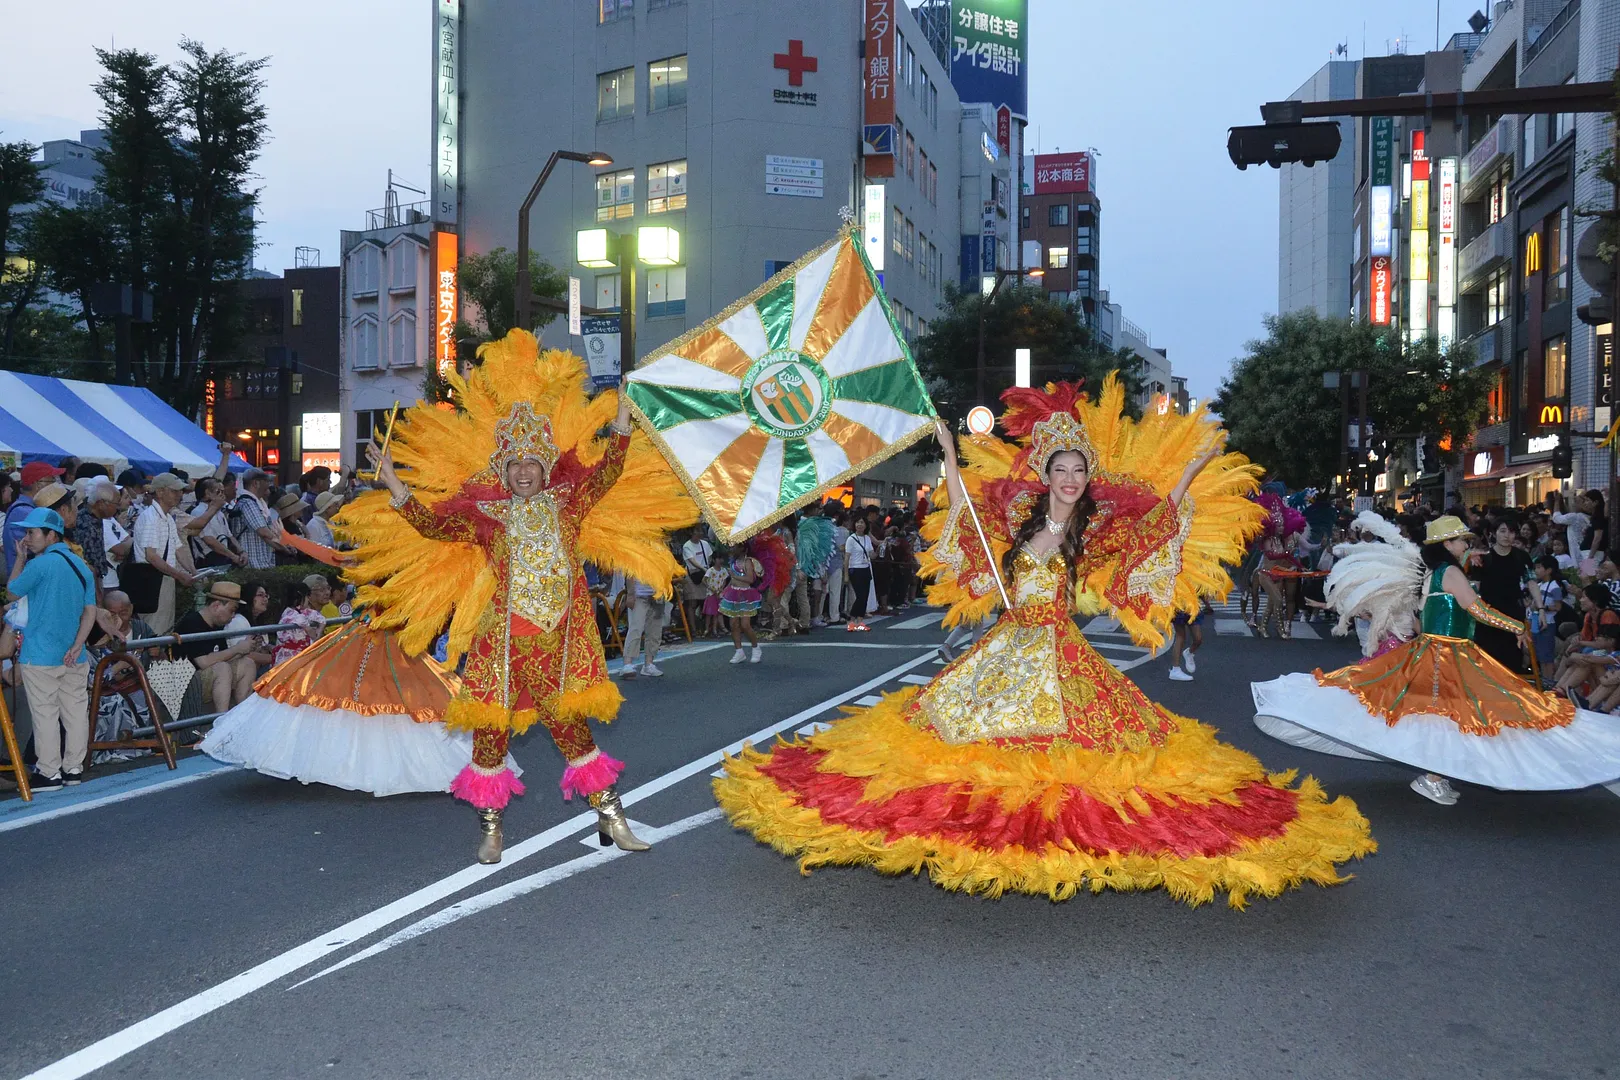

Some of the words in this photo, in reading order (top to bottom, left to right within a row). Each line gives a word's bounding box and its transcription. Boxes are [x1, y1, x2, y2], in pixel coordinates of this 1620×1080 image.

[958, 7, 1019, 39] 分譲住宅
[441, 14, 454, 125] 大宮献血ルーム
[870, 0, 890, 99] スター銀行
[953, 35, 1021, 76] アイダ設計
[442, 134, 453, 192] ウエスト
[1037, 167, 1086, 183] 松本商会
[772, 426, 810, 438] FUNDADO
